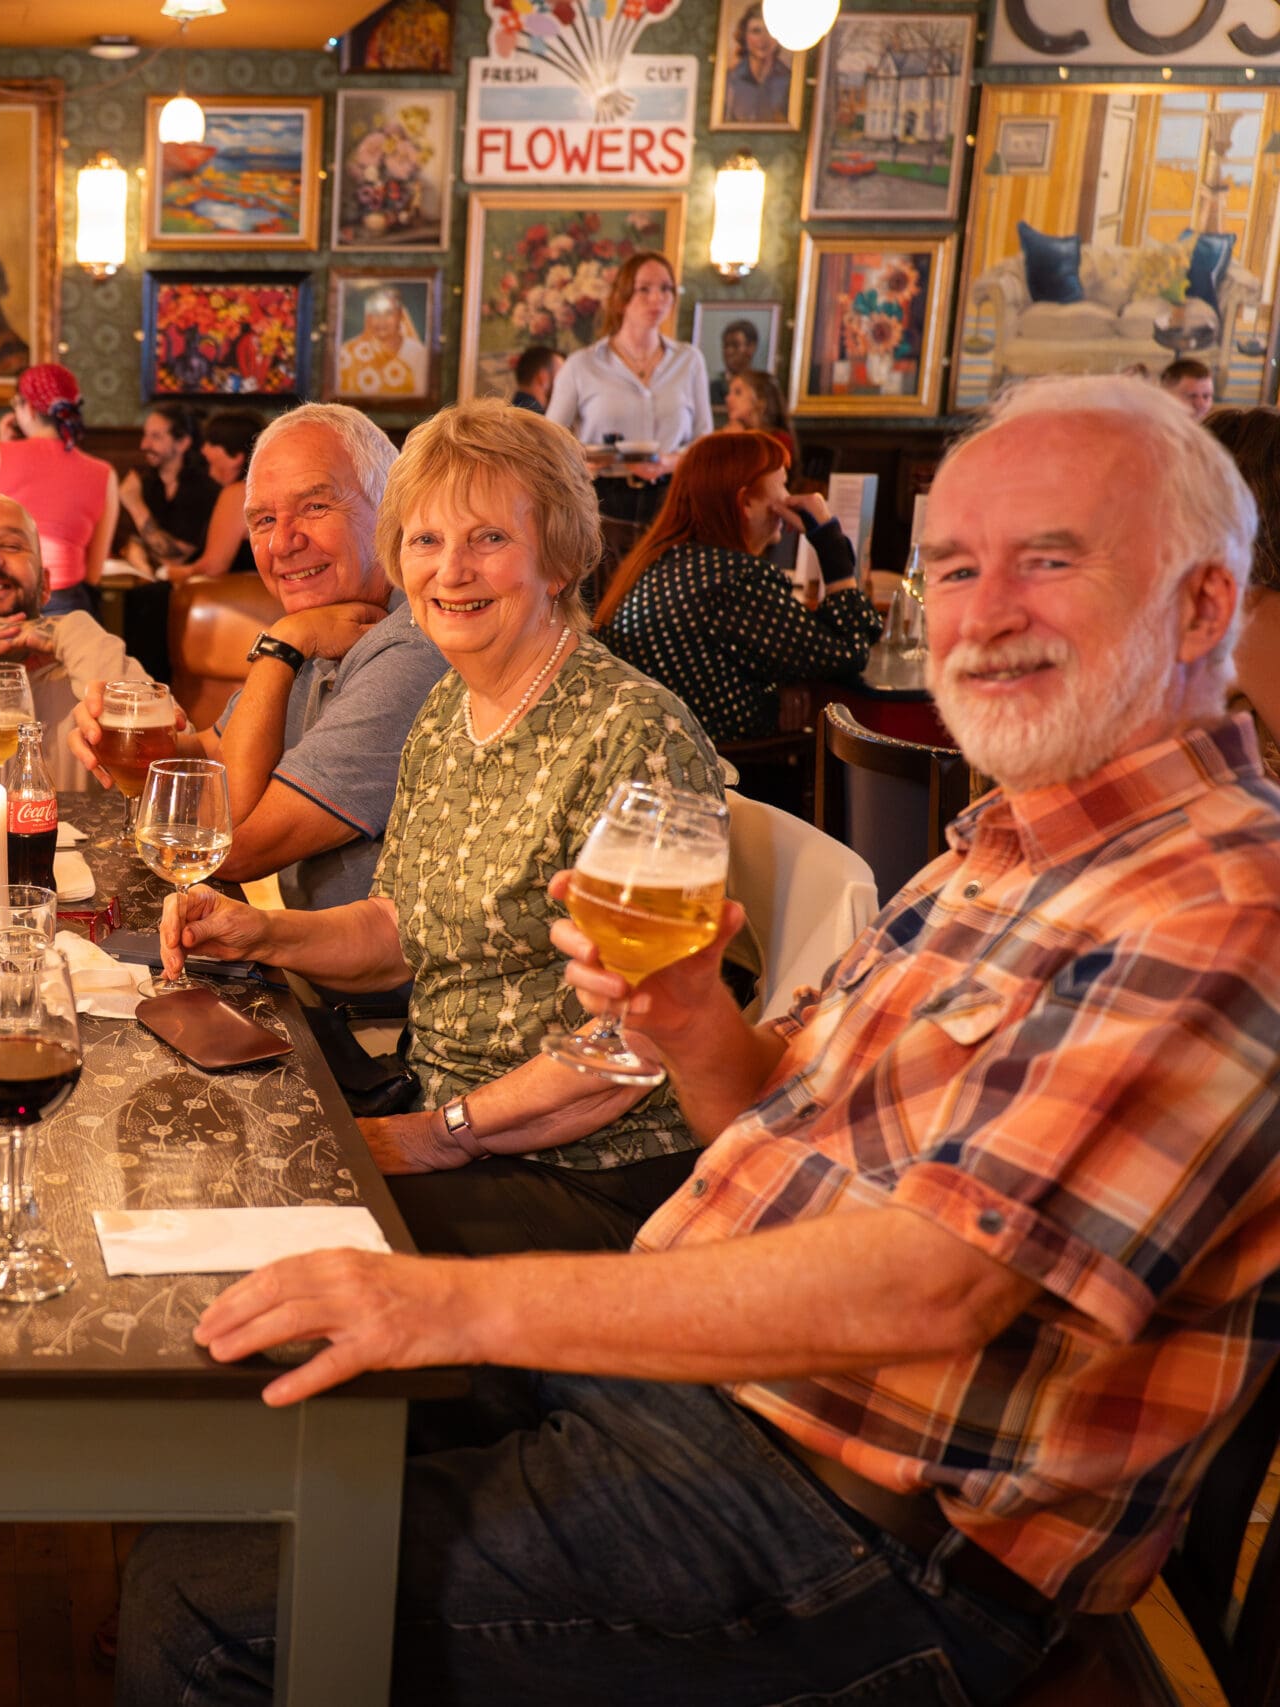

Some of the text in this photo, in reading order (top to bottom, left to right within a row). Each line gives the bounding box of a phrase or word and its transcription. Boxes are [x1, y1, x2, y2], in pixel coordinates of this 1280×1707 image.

[481, 67, 686, 82] FRESH CUT
[477, 128, 687, 175] FLOWERS
